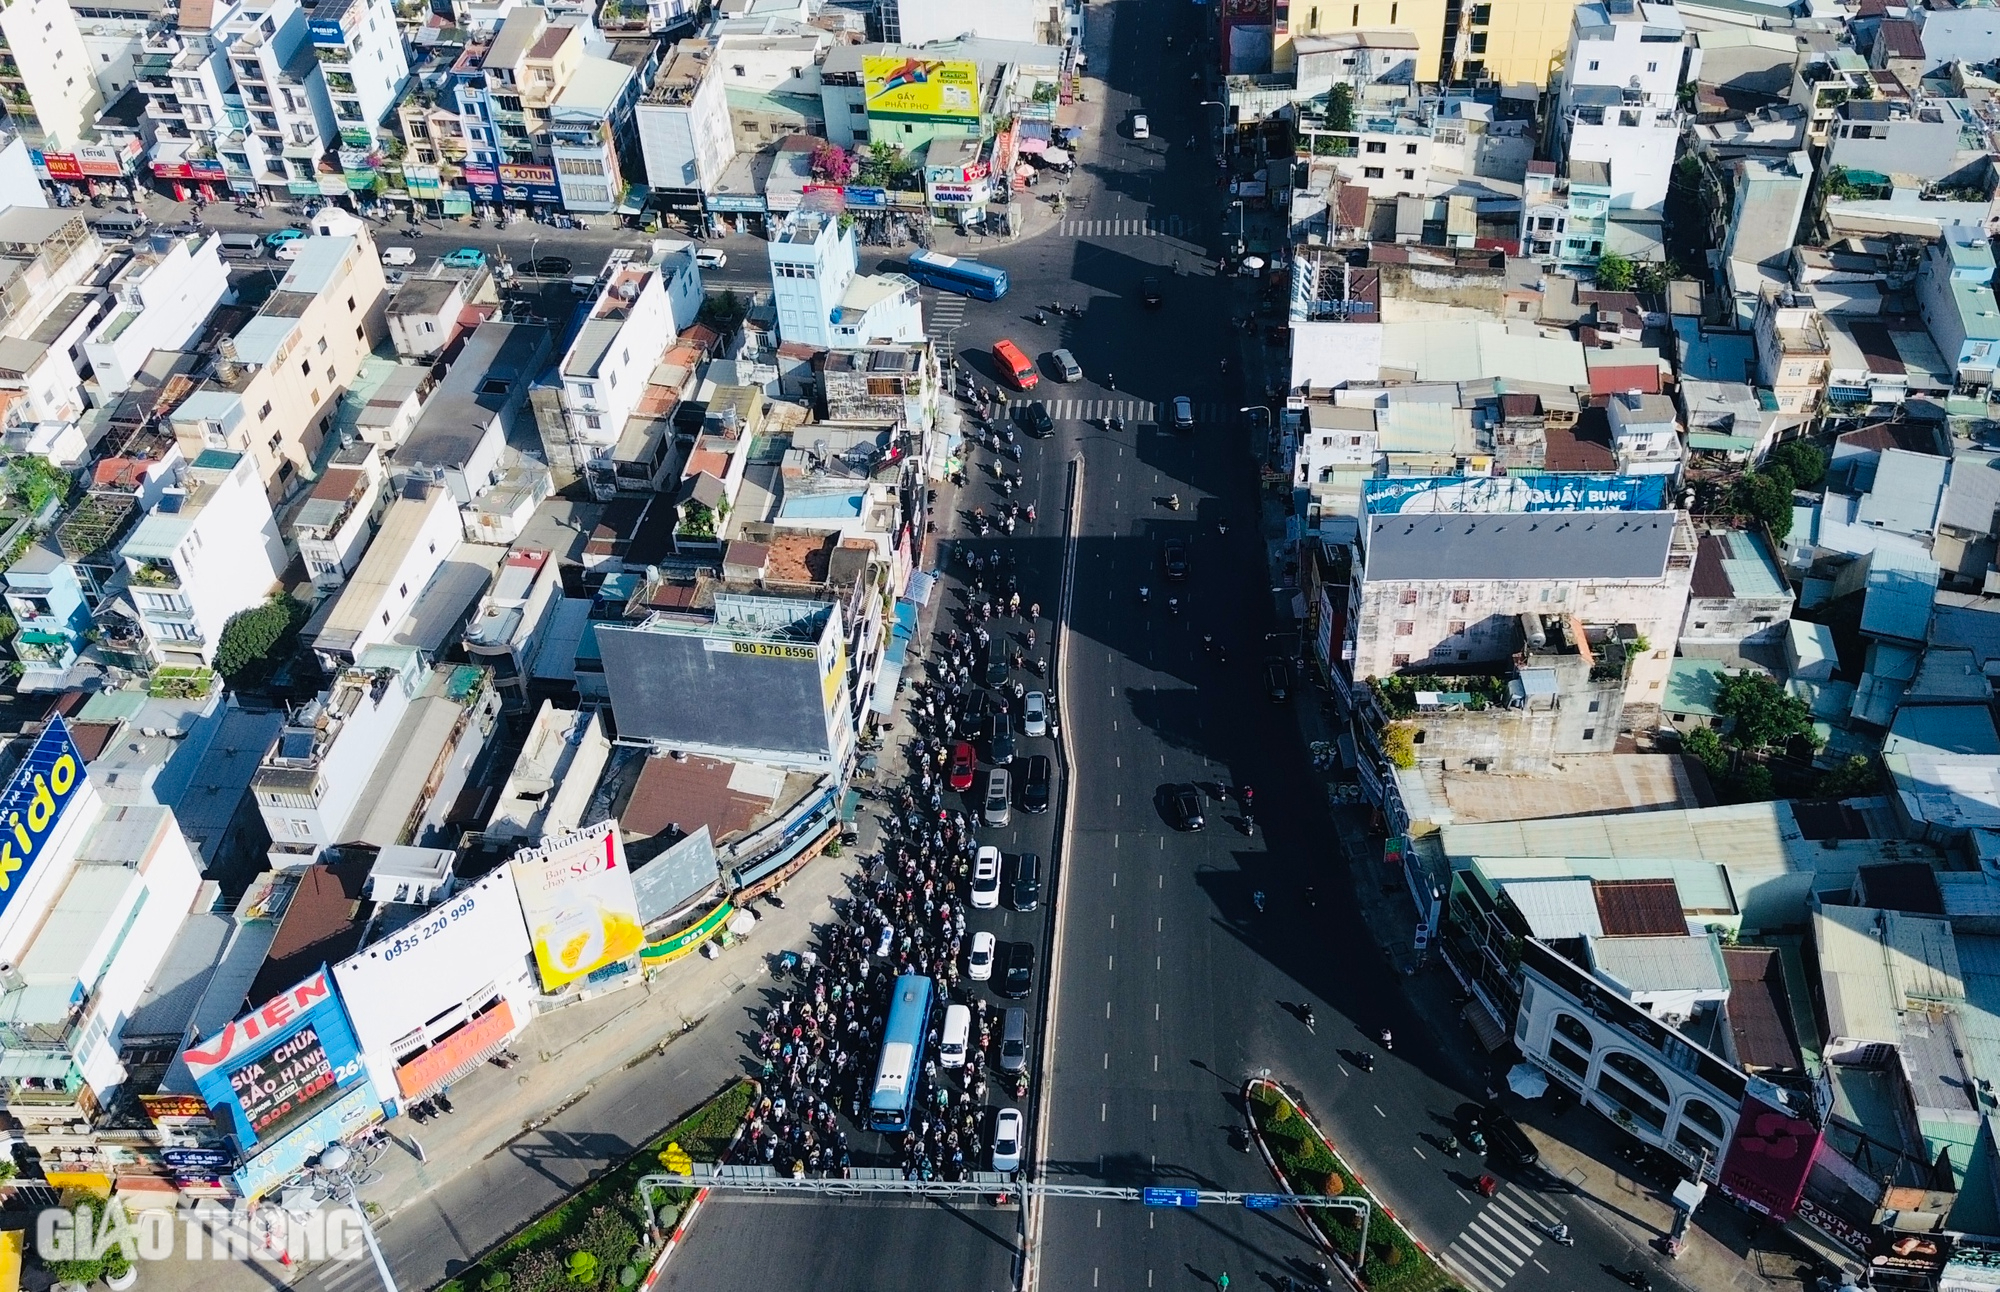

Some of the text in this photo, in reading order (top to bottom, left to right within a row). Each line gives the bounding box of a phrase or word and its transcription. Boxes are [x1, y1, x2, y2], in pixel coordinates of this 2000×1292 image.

[513, 169, 552, 180] JOTUN
[935, 193, 965, 202] QUANG
[1526, 483, 1627, 503] QUẨY BUNG
[735, 642, 814, 659] 090 370 8596
[384, 899, 476, 962] 0935 220 999
[275, 1082, 297, 1101] LAPTOP
